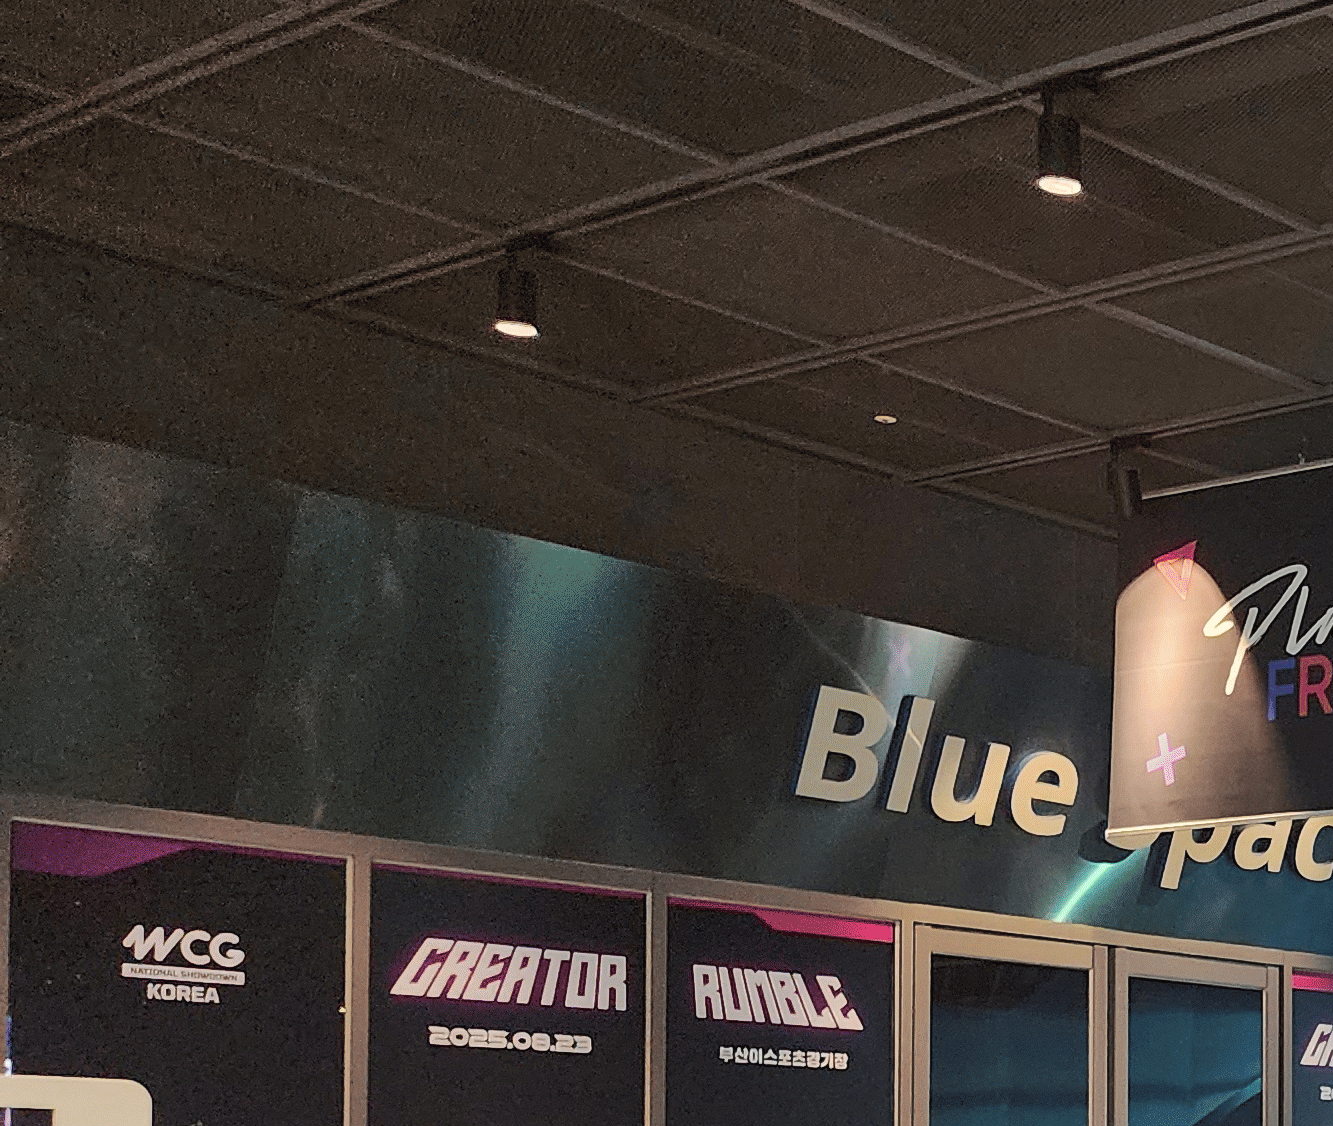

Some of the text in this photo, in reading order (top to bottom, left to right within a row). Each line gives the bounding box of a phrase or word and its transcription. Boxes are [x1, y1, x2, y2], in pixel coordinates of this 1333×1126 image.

[795, 684, 1079, 838] Blue
[122, 924, 246, 967] WCG
[130, 966, 178, 978] NATIONAL
[389, 937, 627, 1011] CREATOR
[147, 982, 221, 1003] KOREA
[693, 963, 864, 1031] RUMBLE
[428, 1025, 593, 1053] 2025.08.23
[718, 1046, 849, 1071] 부산이스포츠경기장
